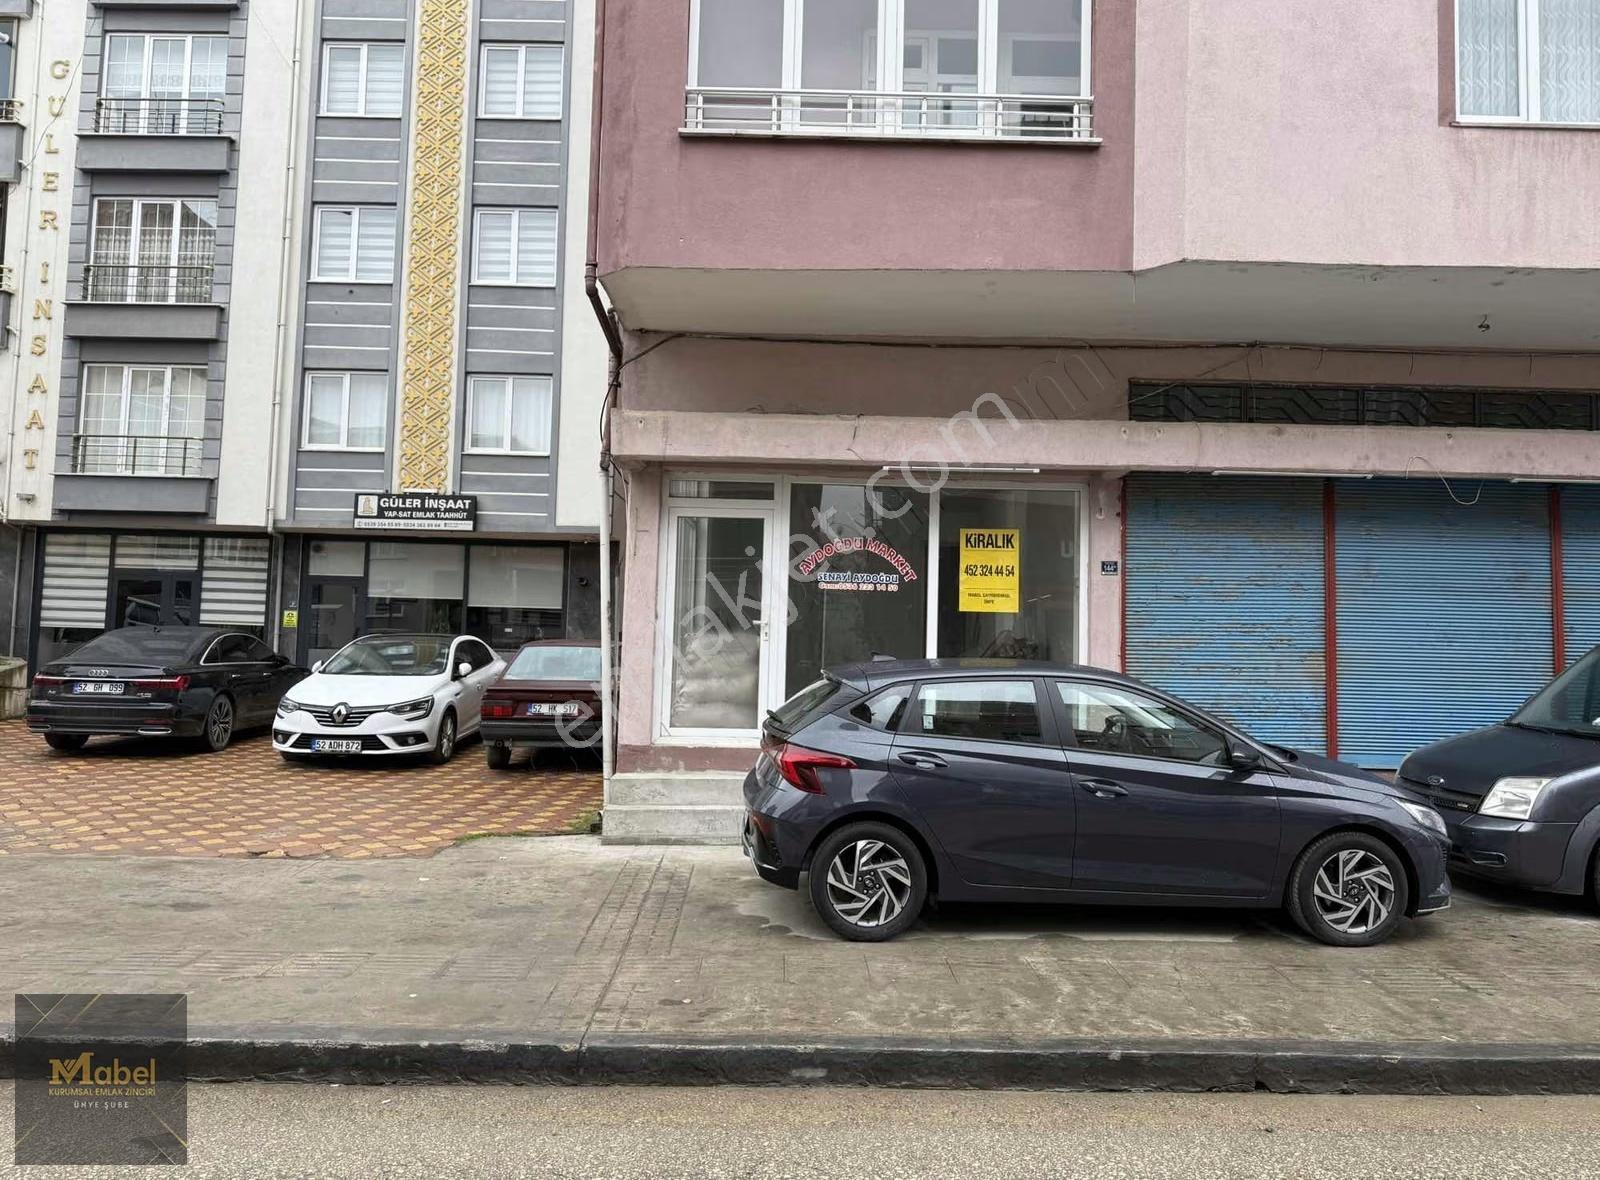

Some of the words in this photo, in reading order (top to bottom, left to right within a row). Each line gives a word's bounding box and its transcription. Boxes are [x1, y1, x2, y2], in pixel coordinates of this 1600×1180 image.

[380, 496, 421, 508] GÜLER
[424, 496, 472, 511] İNŞAAT
[384, 510, 411, 518] YAP-SAT
[436, 510, 468, 519] TAAHHÜT
[799, 537, 864, 575] AYDOĞDU
[865, 537, 917, 582] MARKET
[964, 564, 978, 577] 452
[979, 564, 993, 577] 324
[994, 564, 1004, 577] 44
[1005, 565, 1015, 577] 54
[853, 573, 899, 583] AYDOĞDU
[78, 683, 88, 691] 52
[93, 683, 103, 692] GH
[533, 704, 543, 712] 52
[316, 741, 327, 749] 52
[328, 741, 343, 750] ADH
[345, 741, 361, 750] 872
